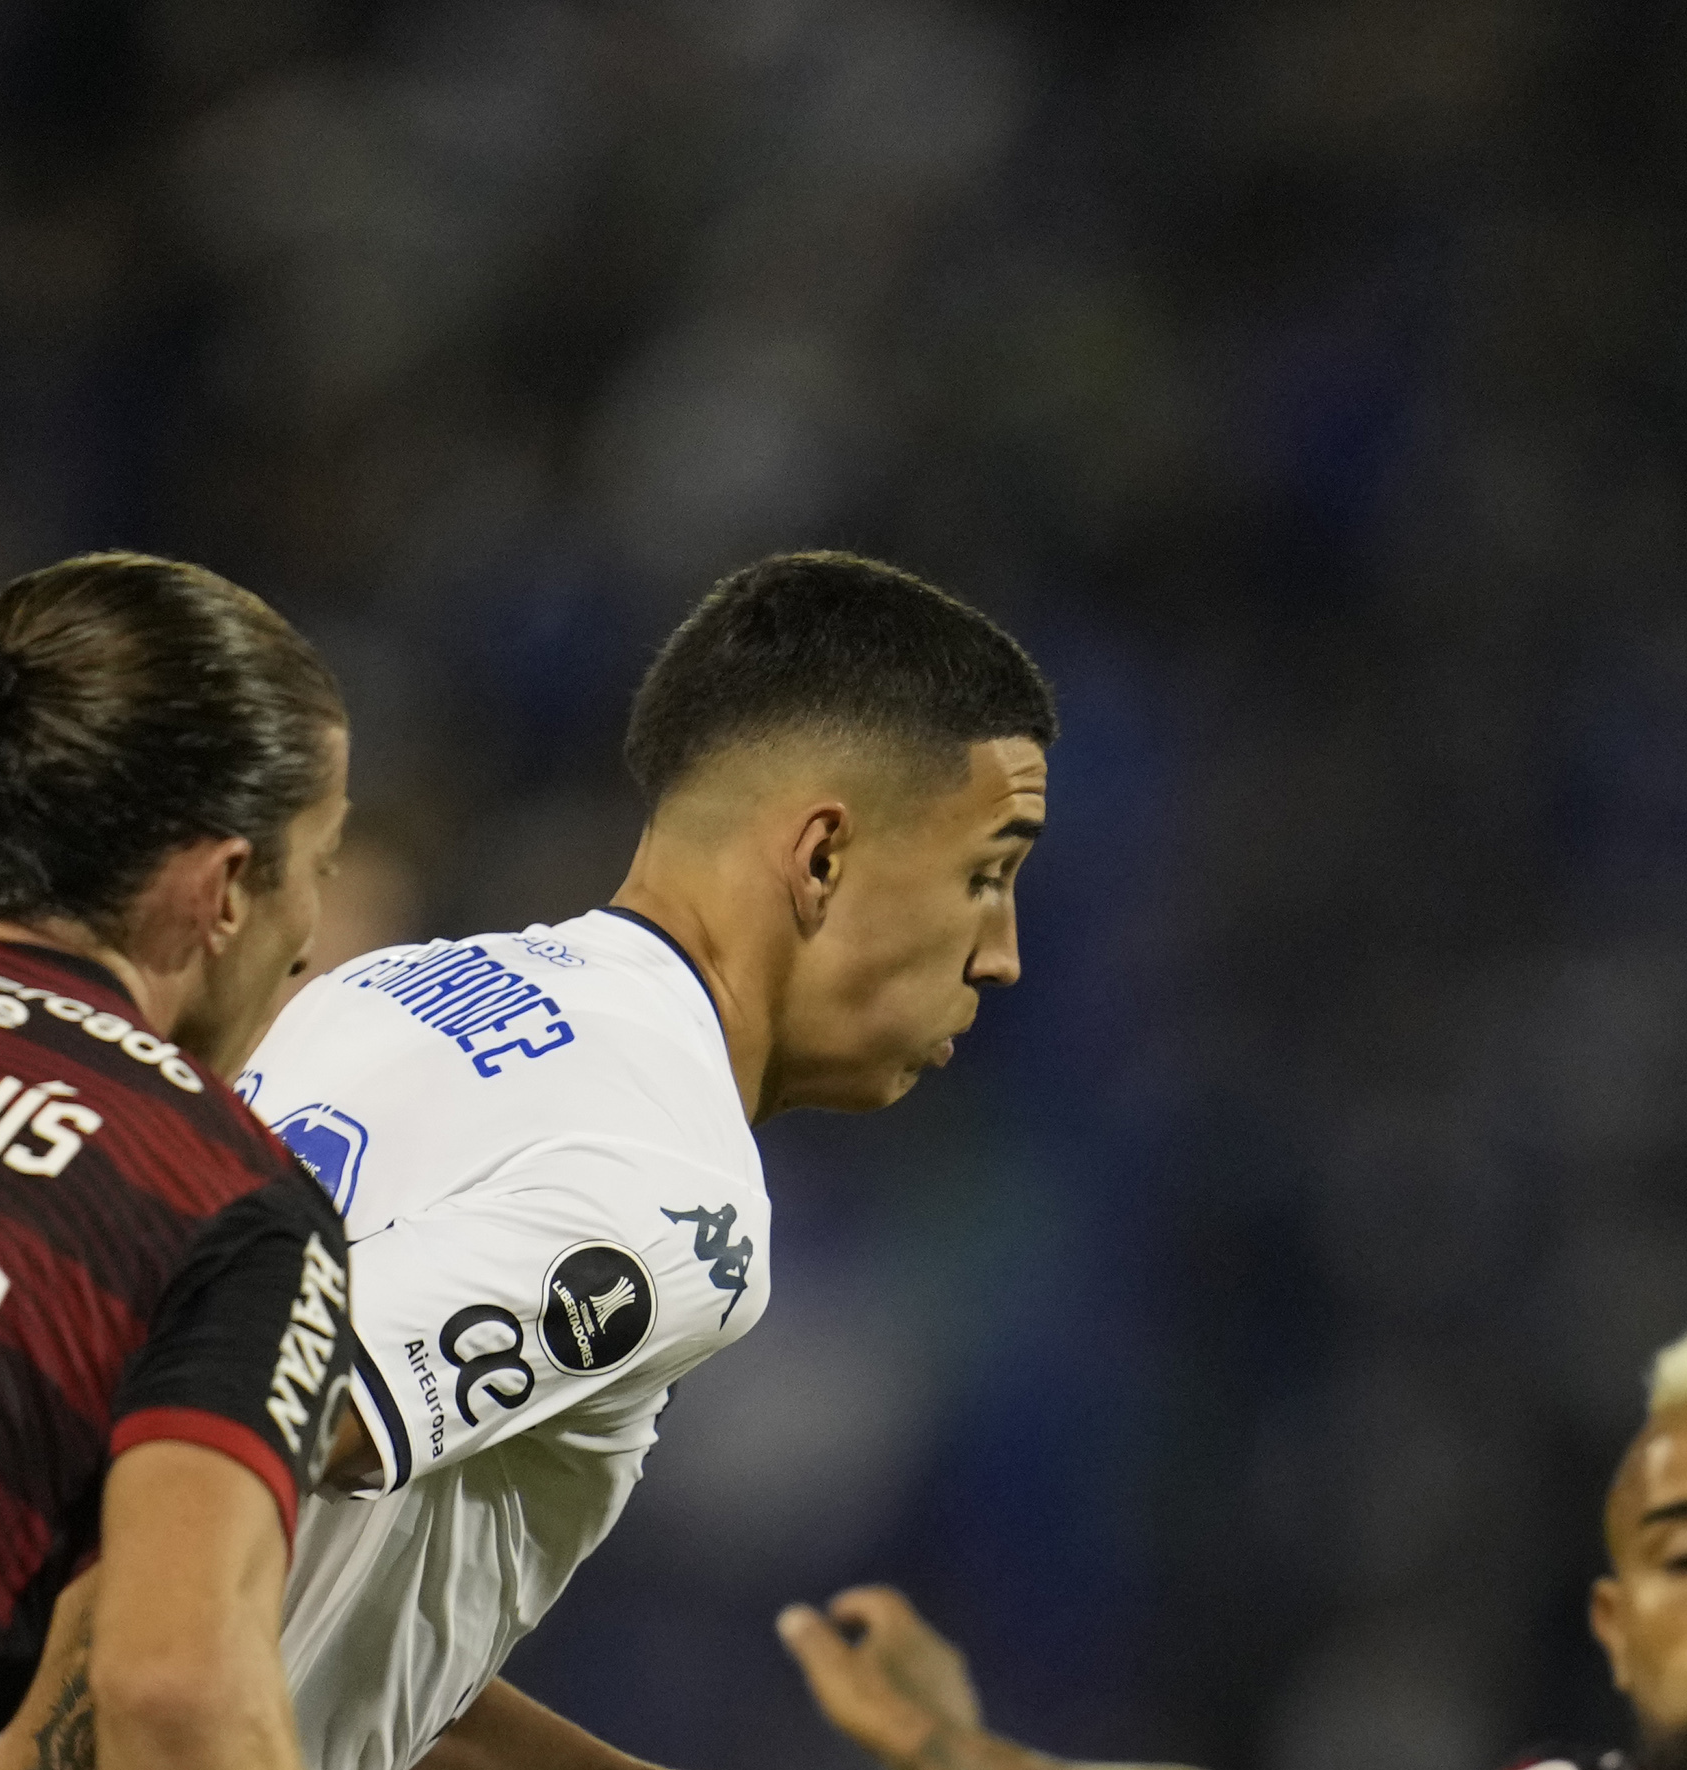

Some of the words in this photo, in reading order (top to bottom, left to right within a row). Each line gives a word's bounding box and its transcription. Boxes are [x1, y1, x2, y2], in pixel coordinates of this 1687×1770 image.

[266, 1231, 347, 1455] HAVAN
[551, 1279, 595, 1368] LIBERTADORES
[404, 1338, 445, 1460] AirEuropa
